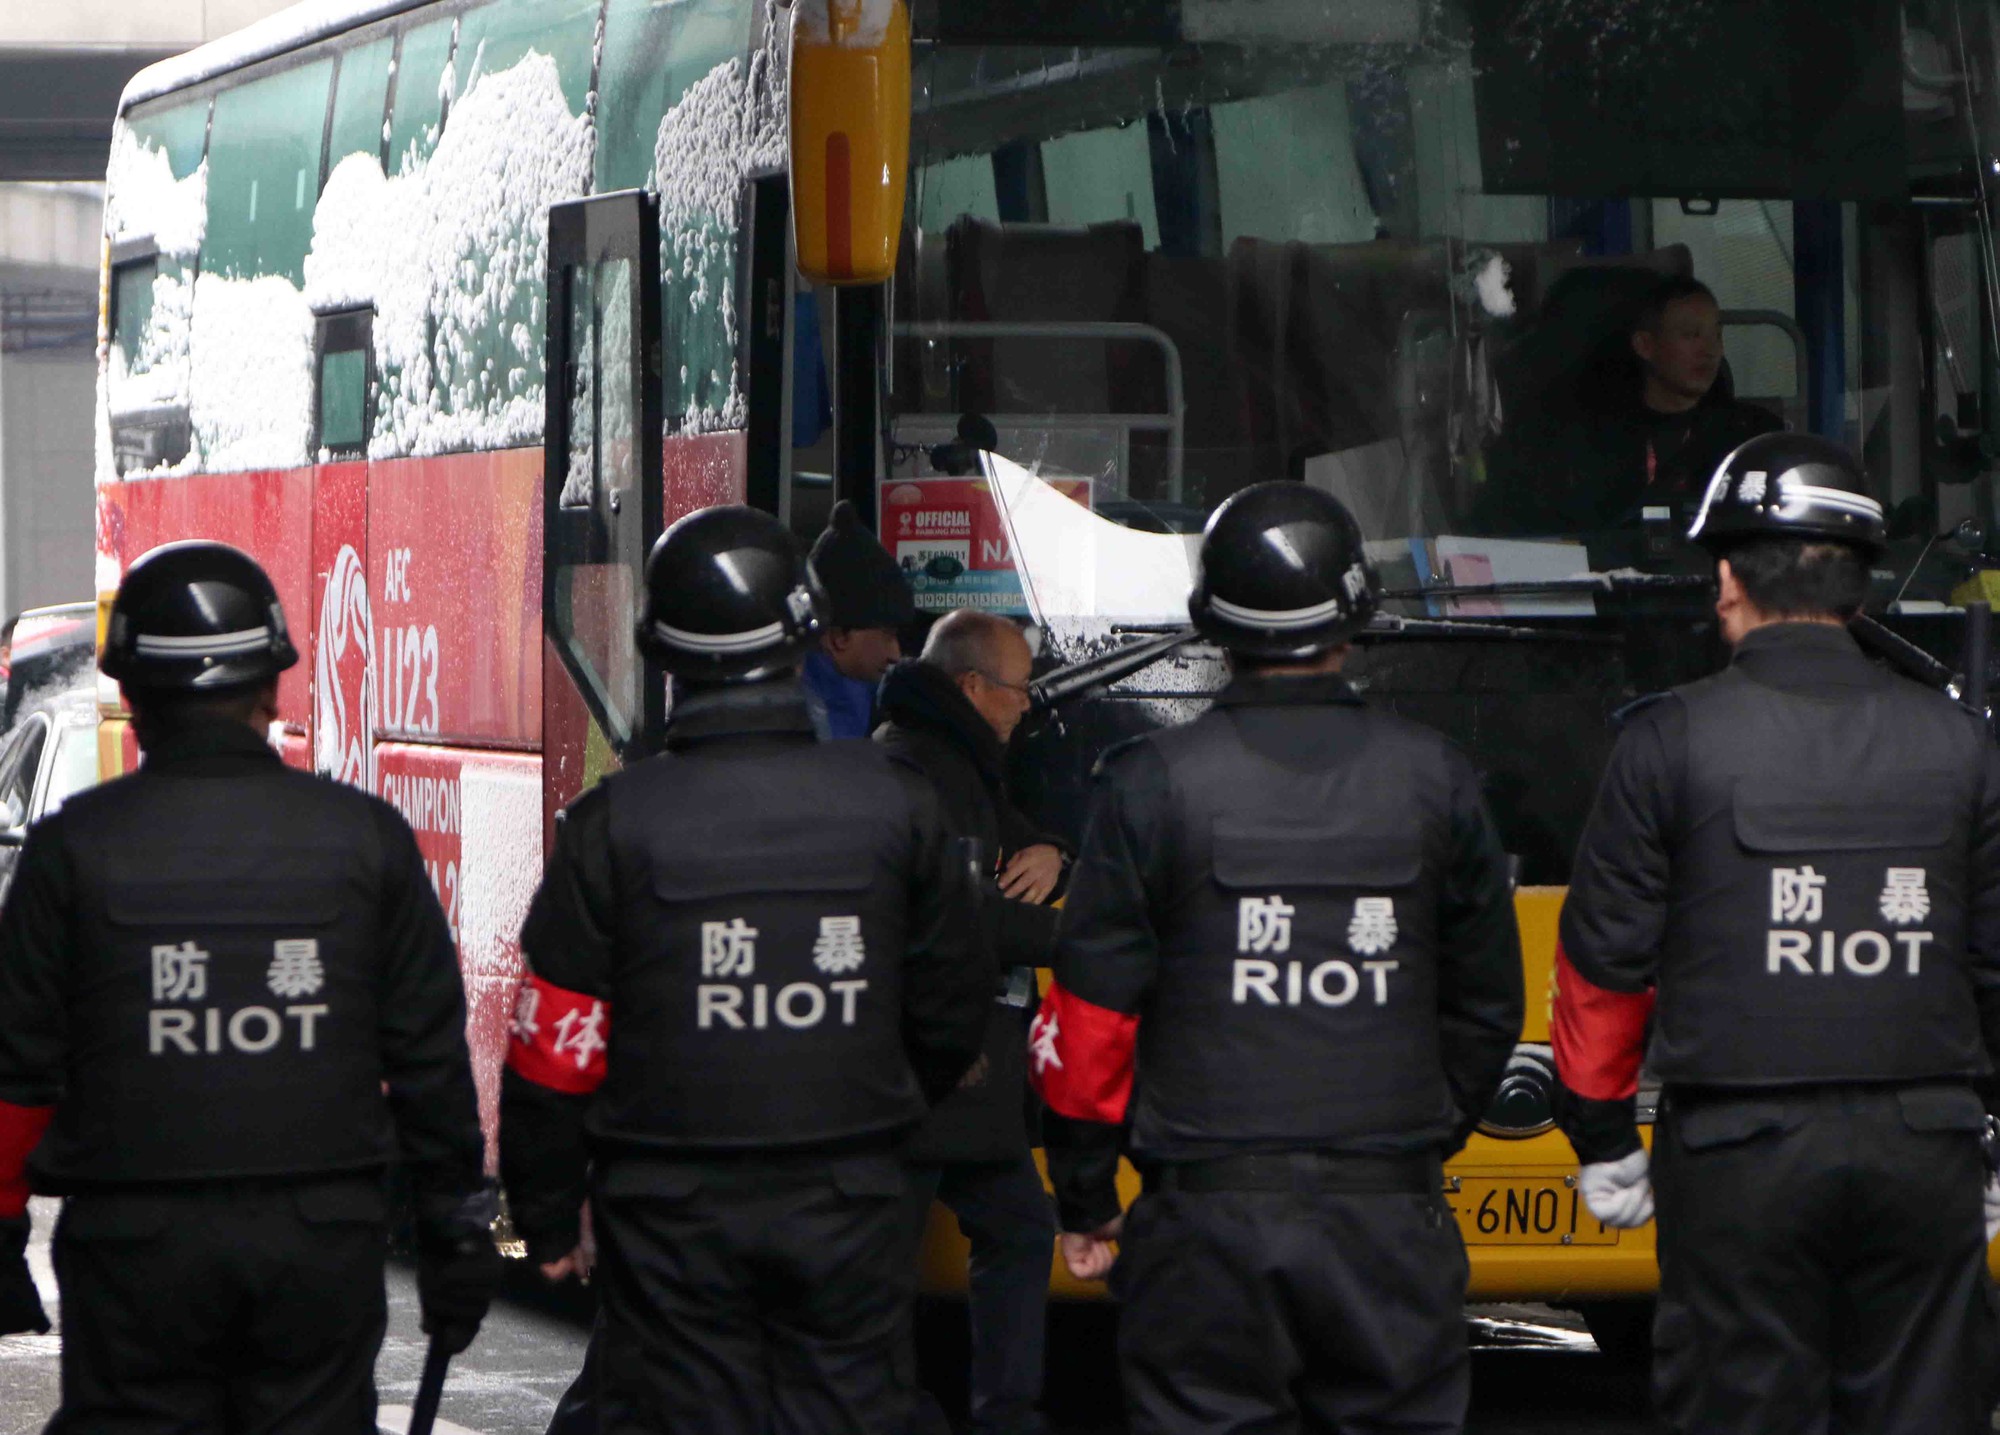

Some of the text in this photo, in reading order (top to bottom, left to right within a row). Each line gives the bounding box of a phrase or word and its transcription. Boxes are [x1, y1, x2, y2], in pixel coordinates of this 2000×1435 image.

[915, 511, 971, 527] OFFICIAL
[384, 547, 411, 603] AFC
[383, 624, 439, 737] U23
[1767, 930, 1933, 976] RIOT
[697, 980, 868, 1028] RIOT
[1232, 959, 1399, 1006] RIOT
[149, 1005, 328, 1054] RIOT
